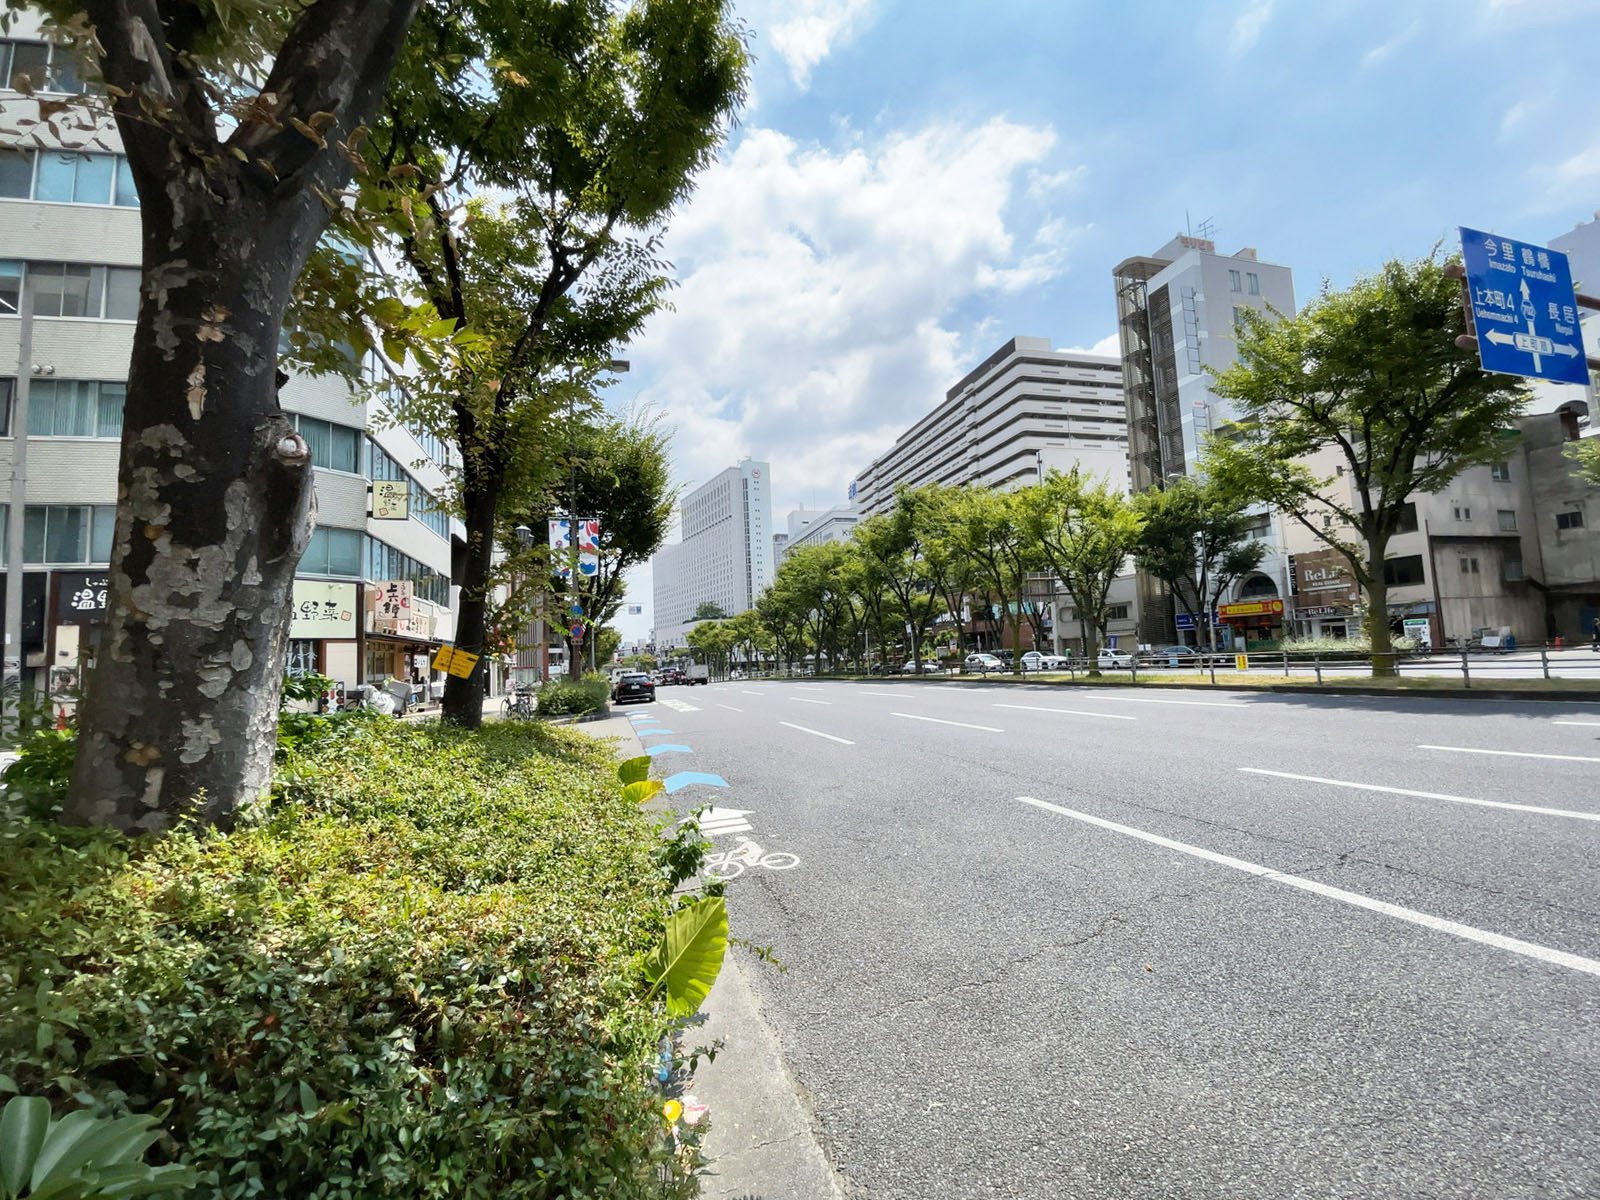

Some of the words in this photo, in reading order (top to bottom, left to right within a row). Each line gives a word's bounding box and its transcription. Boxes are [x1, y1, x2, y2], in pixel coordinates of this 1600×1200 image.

[1484, 239, 1515, 261] 今里
[292, 600, 339, 621] 野菜
[1308, 606, 1336, 615] ReLife
